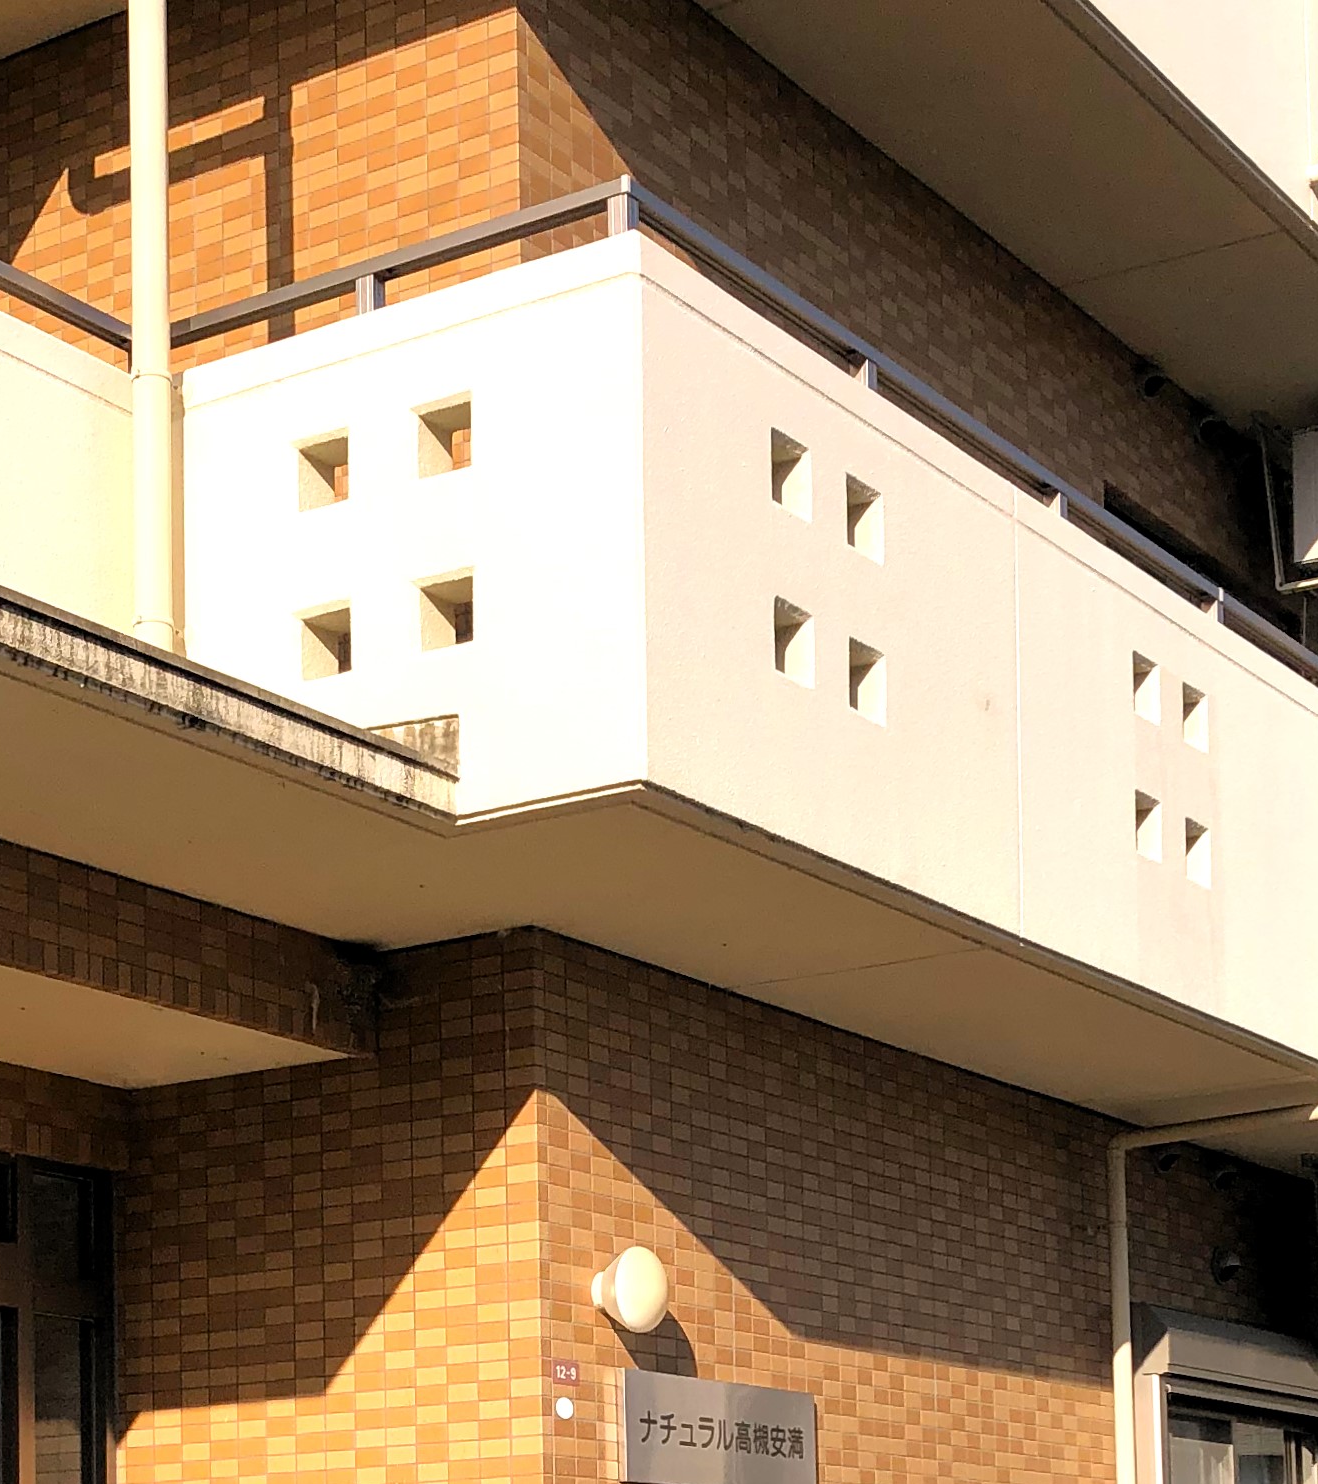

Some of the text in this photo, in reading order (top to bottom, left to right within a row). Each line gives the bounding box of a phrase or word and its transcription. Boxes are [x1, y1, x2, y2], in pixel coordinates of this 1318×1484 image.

[555, 1364, 577, 1381] 12-9
[639, 1410, 804, 1459] ナチュラル高槻安満
